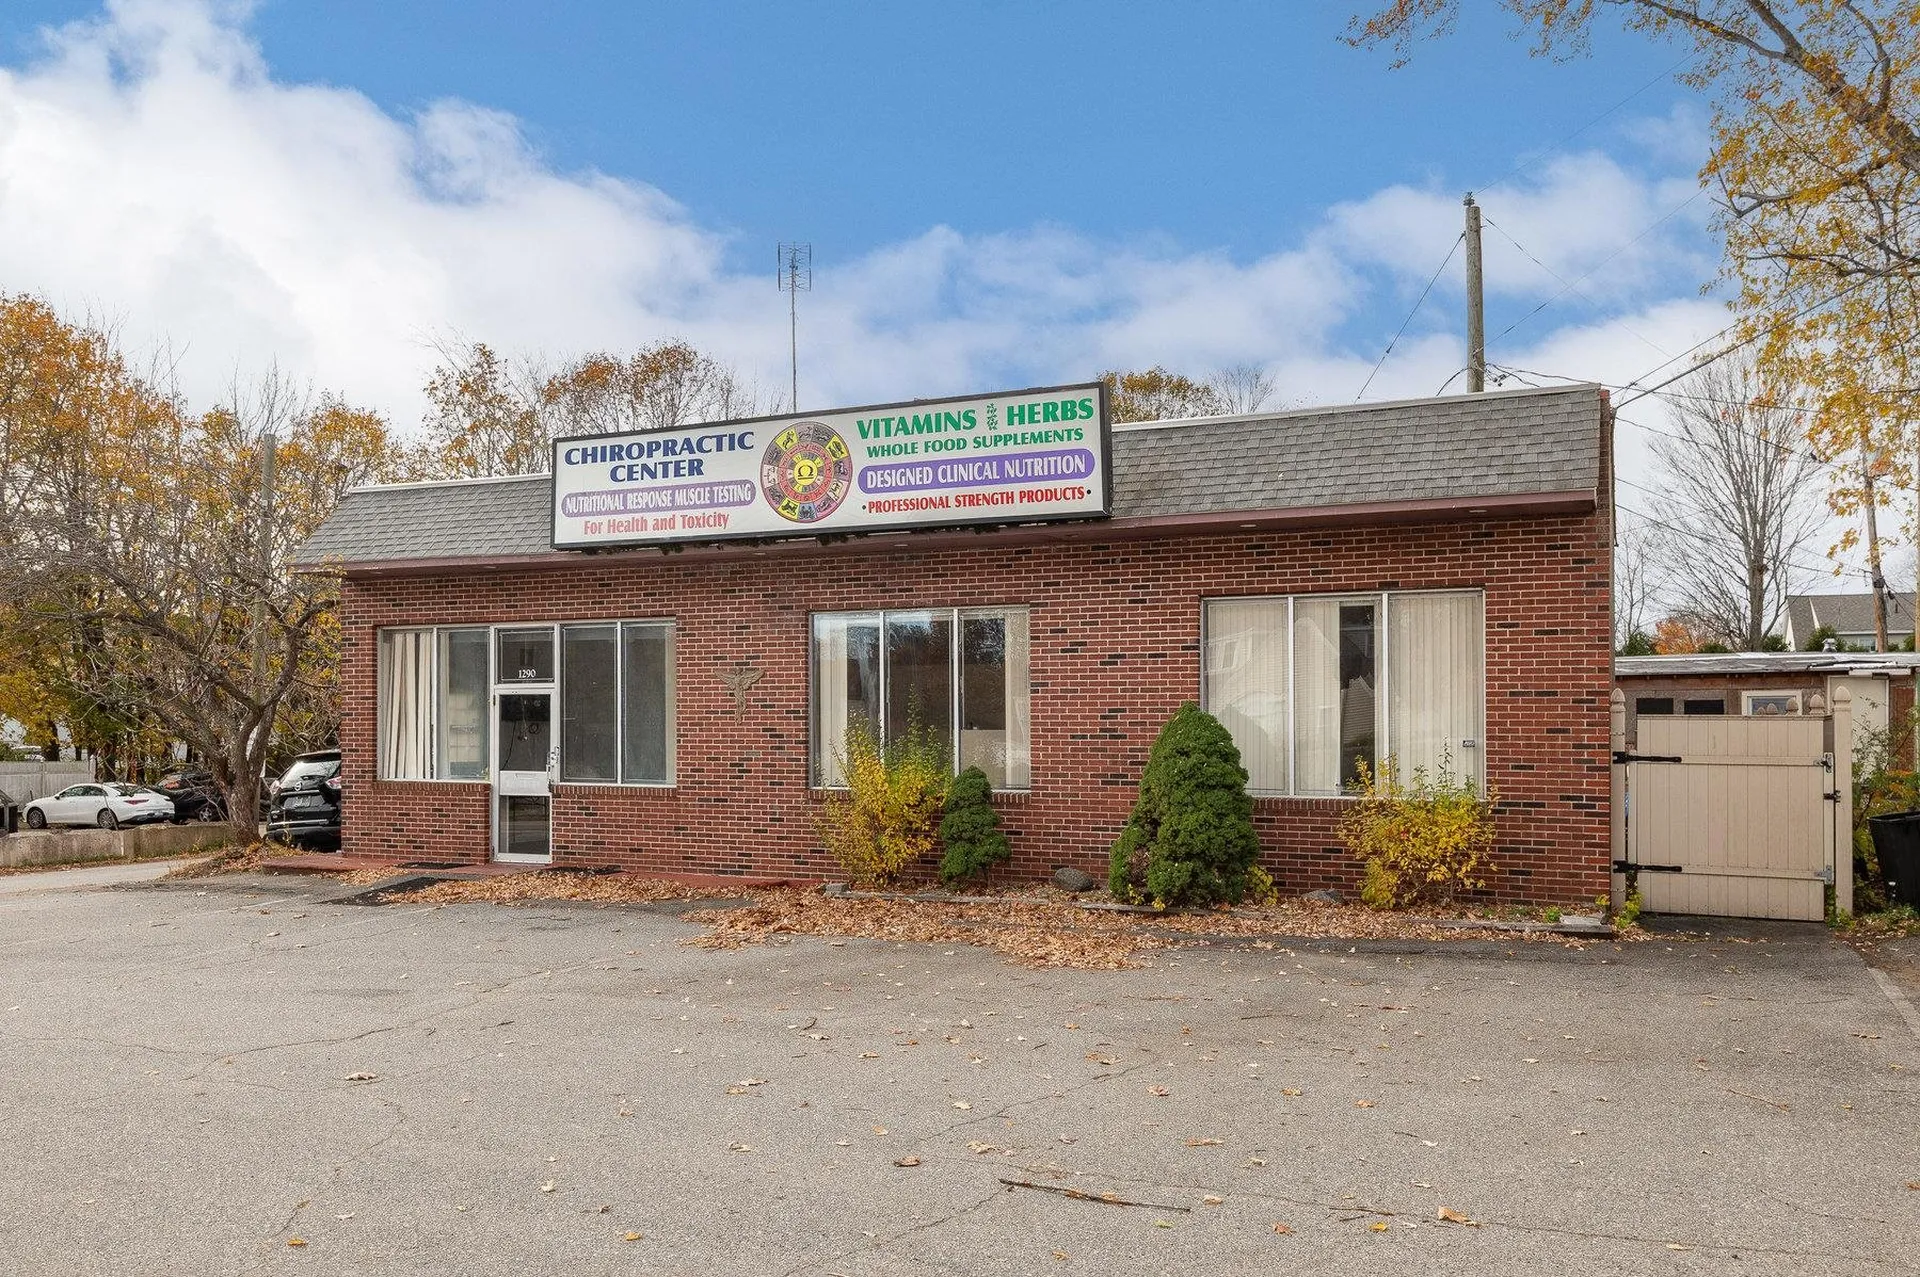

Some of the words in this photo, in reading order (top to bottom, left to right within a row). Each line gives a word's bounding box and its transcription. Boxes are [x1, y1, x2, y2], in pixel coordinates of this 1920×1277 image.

[856, 409, 977, 440] VITAMINS
[1006, 397, 1094, 426] HERBS
[564, 431, 755, 466] CHIROPRACTIC
[866, 442, 918, 458] WHOLE
[924, 437, 967, 453] FOOD
[973, 428, 1084, 449] SUPPLEMENTS
[609, 458, 704, 482] CENTER
[866, 466, 933, 489] DESIGNED
[937, 461, 1000, 484] CLINICAL
[1004, 454, 1086, 479] NUTRITION
[565, 493, 625, 514] NUTRITIONAL
[626, 489, 673, 511] RESPONSE
[674, 486, 711, 507] MUSCLE
[711, 483, 752, 504] TESTING
[867, 495, 951, 514] PROFESSIONAL
[954, 490, 1015, 508] STRENGTH
[1019, 486, 1085, 504] PRODUCTS
[583, 520, 604, 535] For
[607, 516, 648, 534] Health
[652, 514, 676, 531] and
[680, 511, 730, 530] Toxicity
[518, 669, 537, 679] 1290
